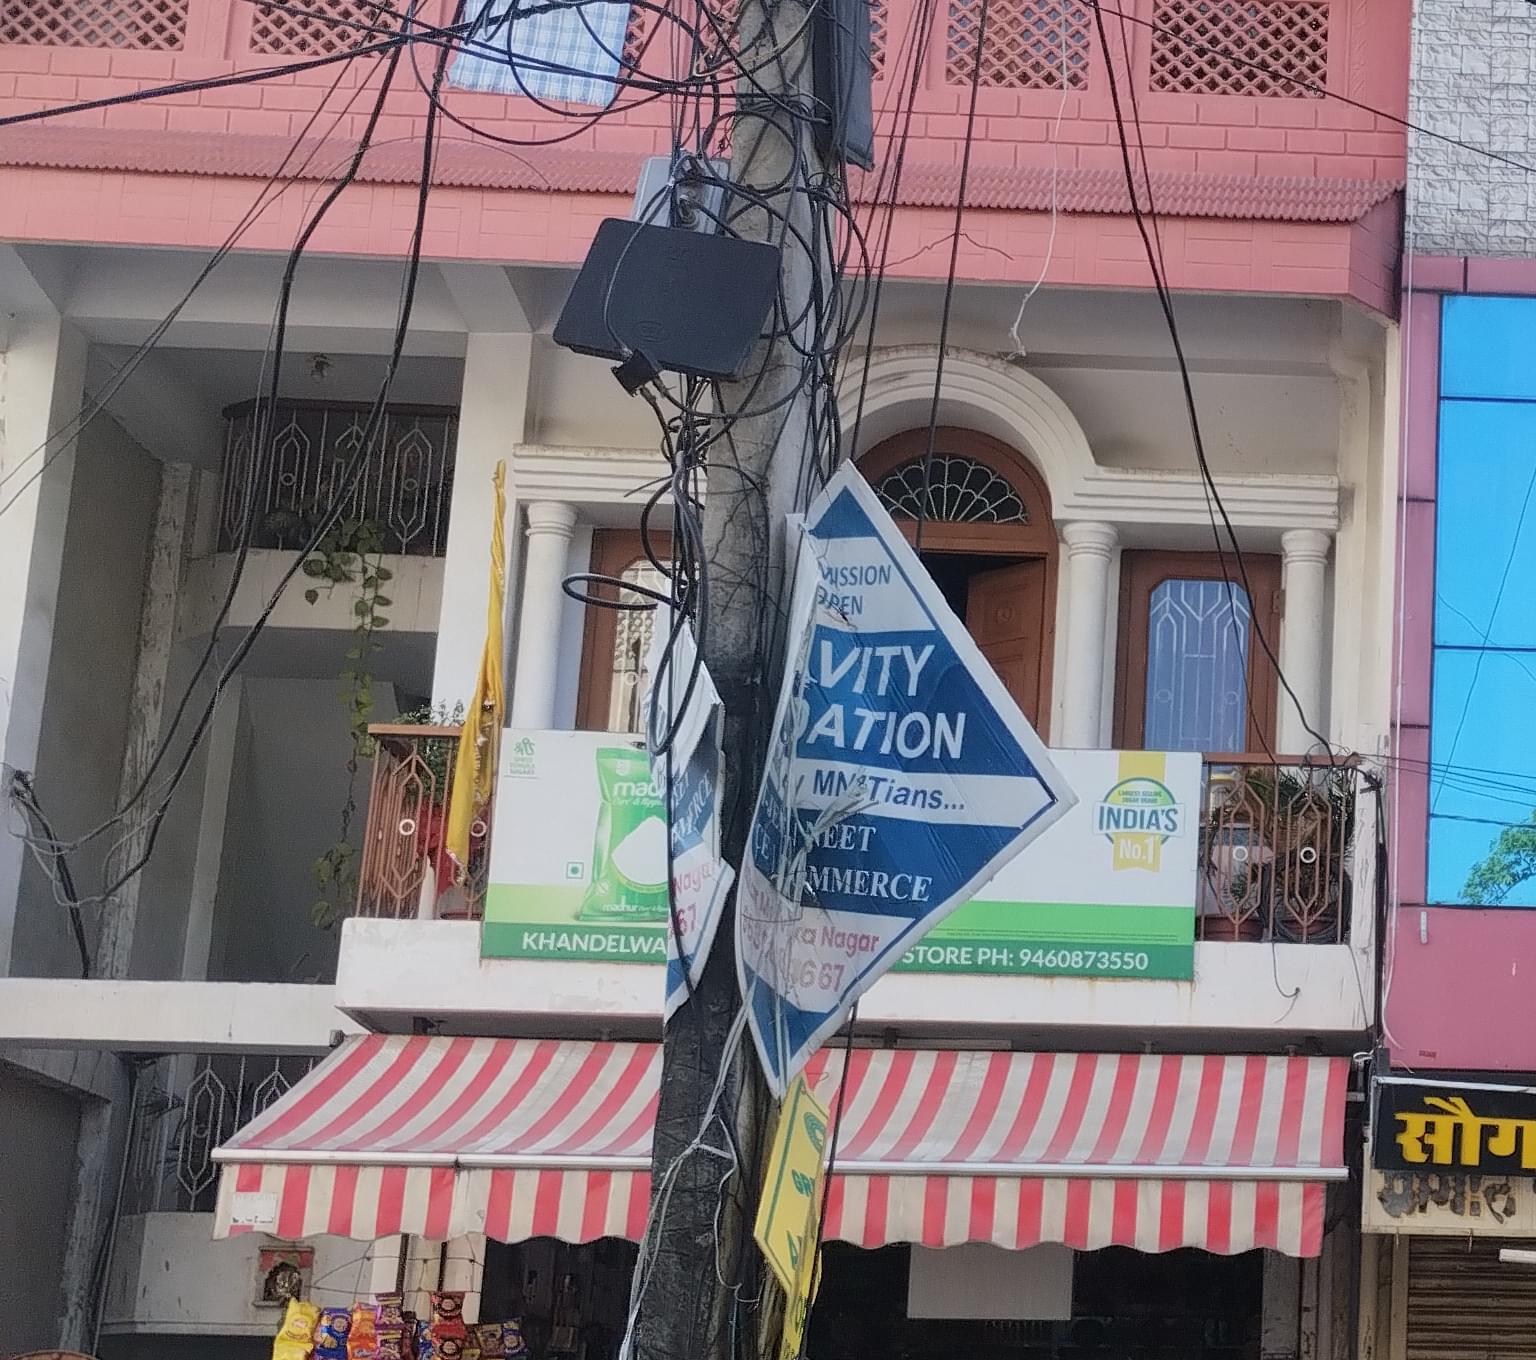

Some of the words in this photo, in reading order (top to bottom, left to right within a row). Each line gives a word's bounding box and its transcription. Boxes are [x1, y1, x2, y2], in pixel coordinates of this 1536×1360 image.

[819, 640, 935, 699] VITY
[1098, 805, 1179, 833] INDIA'S
[521, 931, 667, 955] KHANDELWA
[978, 947, 1014, 967] PH:
[1019, 948, 1149, 971] 9460873550
